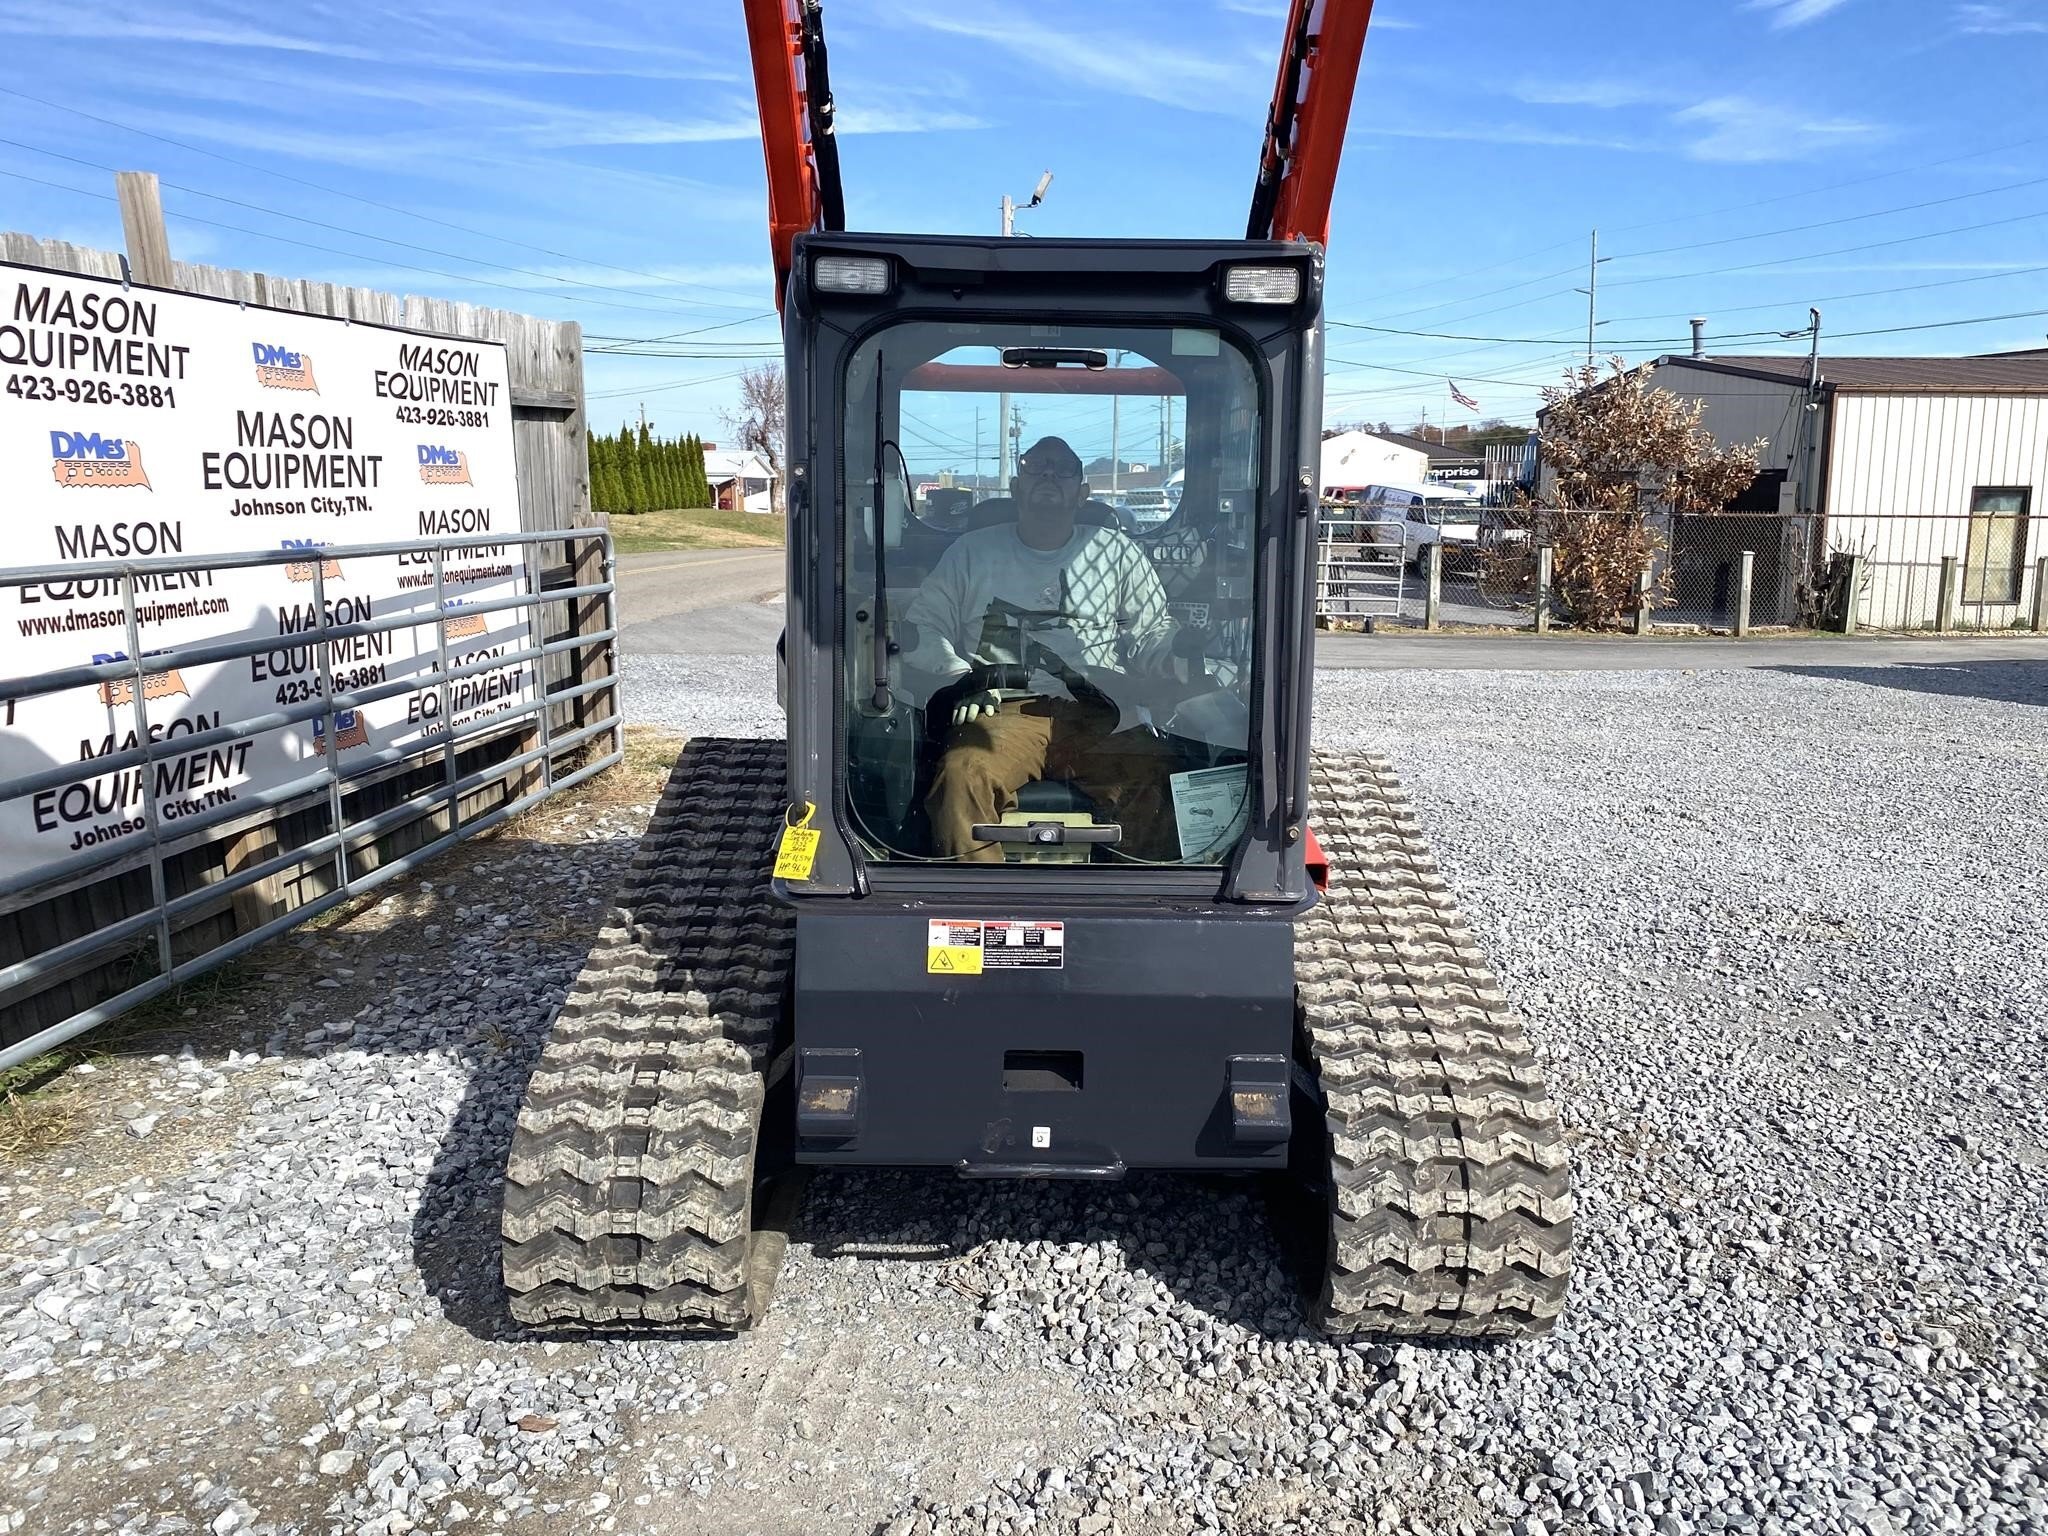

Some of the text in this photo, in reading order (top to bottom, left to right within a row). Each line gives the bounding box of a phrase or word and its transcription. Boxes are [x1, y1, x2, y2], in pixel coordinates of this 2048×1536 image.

[14, 283, 157, 337] MASON
[399, 344, 479, 377] MASON
[6, 374, 176, 409] 423-926-3881
[375, 370, 499, 406] EQUIPMENT
[237, 410, 353, 449] MASON
[396, 405, 489, 428] 423-926-3881
[202, 452, 383, 489] EQUIPMENT
[230, 498, 306, 516] Johnson
[418, 508, 490, 535] MASON
[54, 521, 183, 559] MASON
[397, 563, 513, 589] www.dmsonequipment.com
[18, 596, 230, 637] www.dmasonquipment.com
[279, 595, 371, 635] MASON
[252, 631, 392, 682] EQUIMENT
[70, 816, 146, 850] Johnso
